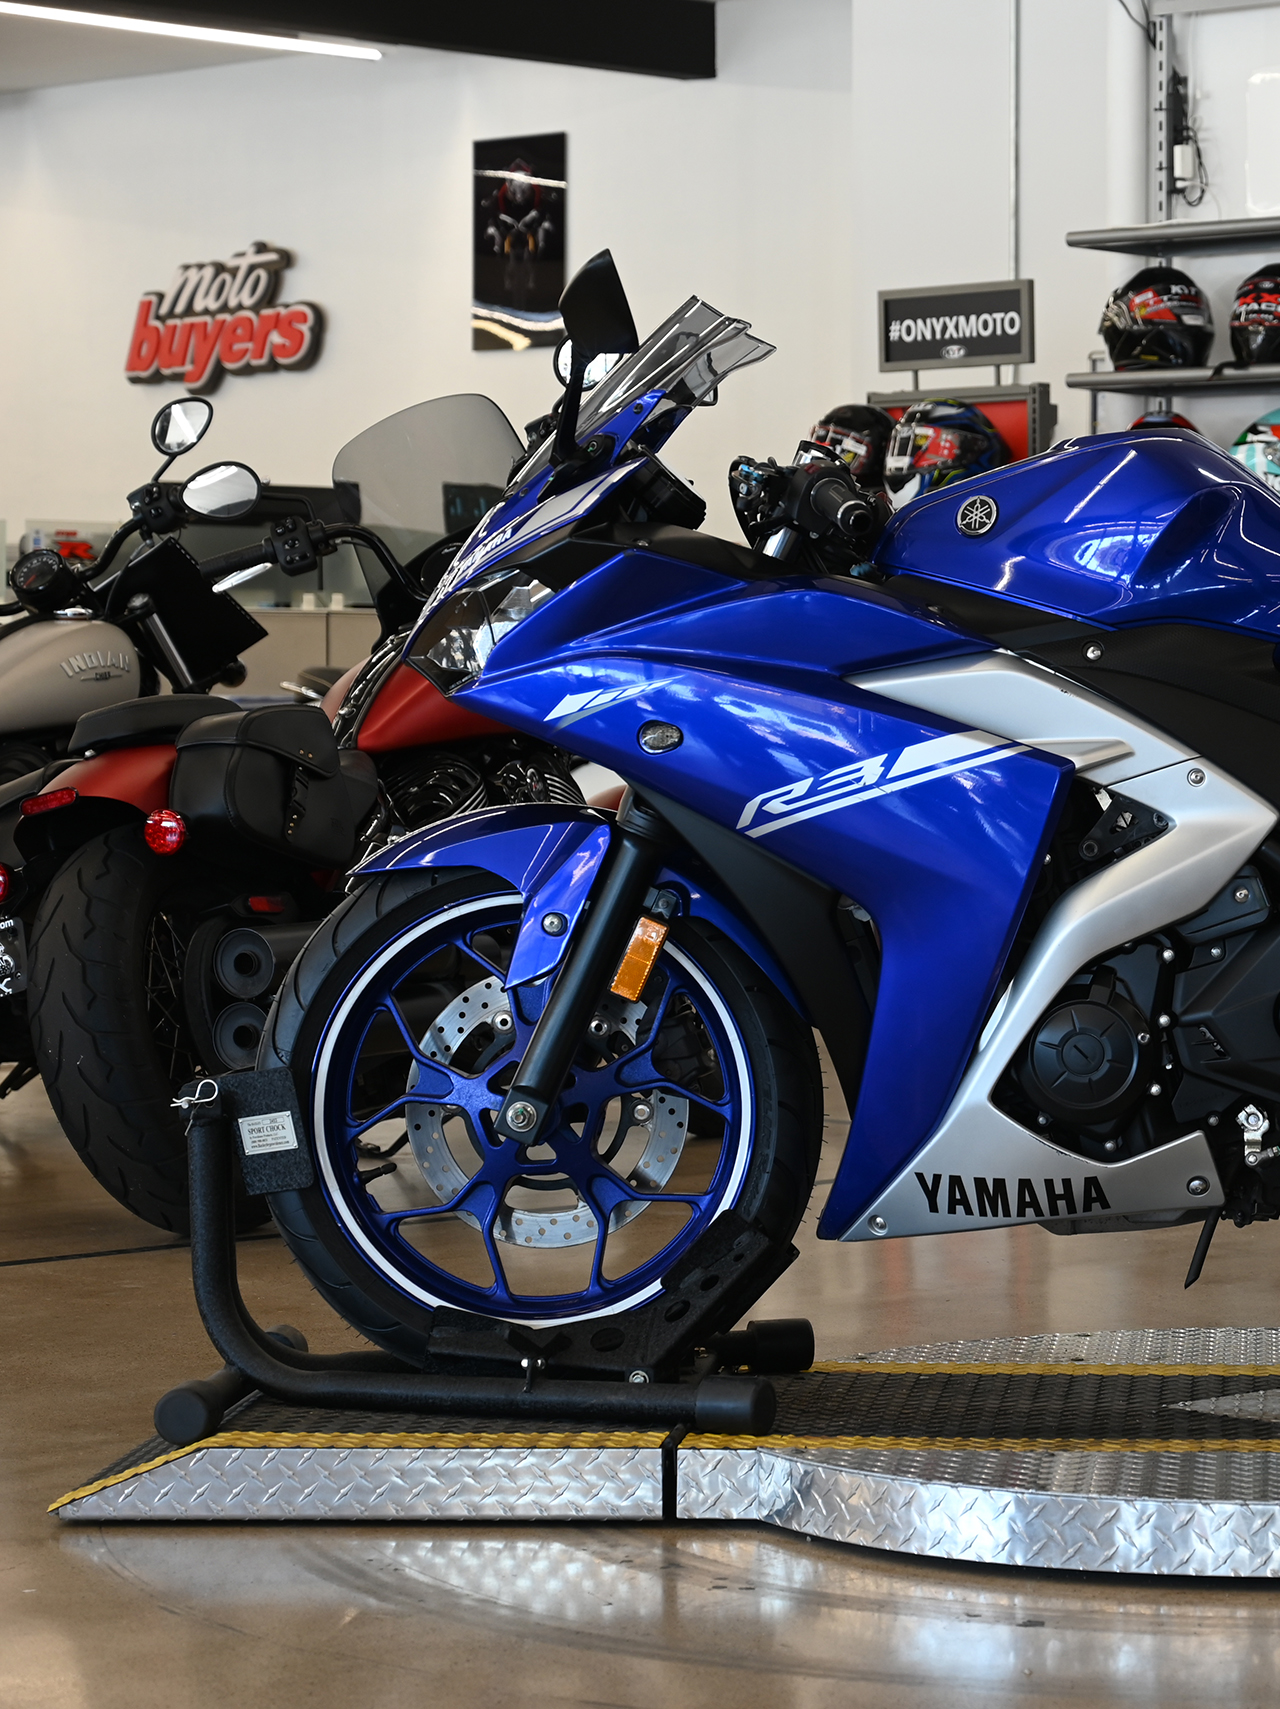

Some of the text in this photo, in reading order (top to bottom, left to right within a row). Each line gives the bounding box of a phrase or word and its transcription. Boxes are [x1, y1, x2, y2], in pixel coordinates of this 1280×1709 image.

[125, 299, 309, 384] buyers
[889, 311, 1021, 343] #ONYXMOTO
[60, 650, 130, 677] INDIAN
[247, 1124, 286, 1135] SPORT CHOCK
[914, 1171, 1112, 1218] YAMAHA
